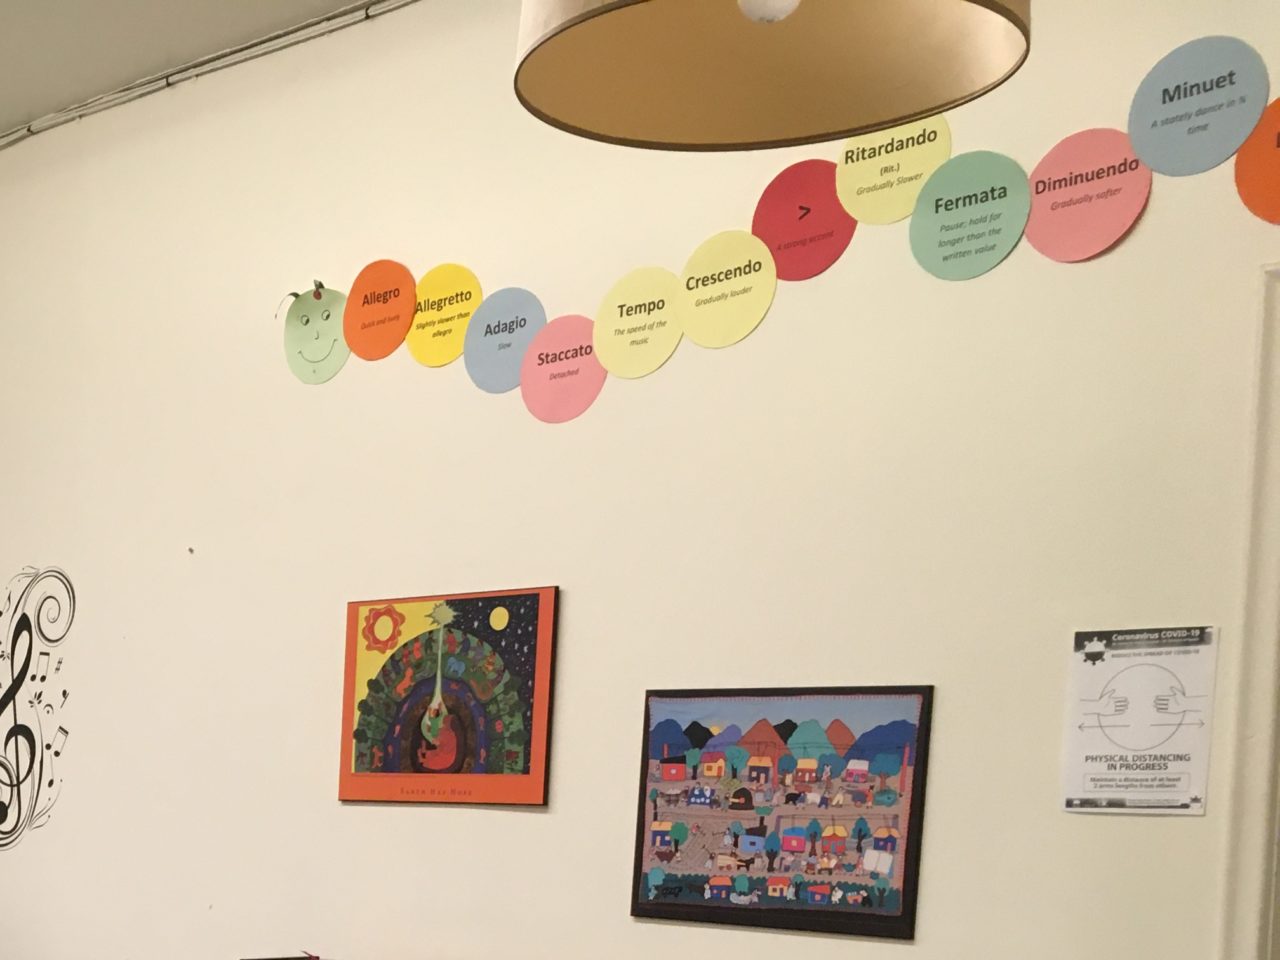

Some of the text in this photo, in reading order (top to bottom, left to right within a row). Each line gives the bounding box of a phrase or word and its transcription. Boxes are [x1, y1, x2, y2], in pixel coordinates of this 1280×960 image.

[1161, 70, 1236, 105] Minuet
[1150, 119, 1159, 130] A
[1160, 111, 1193, 127] stately
[1195, 102, 1224, 117] dance
[1226, 99, 1236, 109] in
[1186, 122, 1209, 136] time
[844, 127, 937, 165] Ritardando
[880, 163, 900, 177] (Rit.)
[1035, 158, 1139, 196] Diminuendo
[856, 171, 924, 196] Gradually Slower
[934, 184, 1008, 214] Fermata
[1050, 187, 1122, 211] Gradually softer
[968, 215, 988, 228] hold
[989, 211, 1002, 226] for
[938, 226, 1002, 250] longer than the
[942, 243, 997, 263] written value
[685, 258, 762, 291] Crescendo
[362, 288, 400, 307] Allegro
[415, 290, 472, 314] Allegretto
[695, 285, 753, 307] Gradually louder
[617, 297, 665, 318] Tempo
[416, 311, 470, 330] Slightly slower than
[484, 316, 527, 337] Adagio
[614, 319, 667, 337] The speed of the
[432, 328, 453, 338] allegro
[630, 336, 649, 347] music
[497, 341, 512, 351] Slow
[537, 343, 593, 366] Staccato
[549, 367, 580, 381] Detached
[1112, 629, 1200, 641] Coronavirus COVID-19
[1085, 753, 1191, 762] PHYSICAL DISTANCING
[1107, 762, 1169, 771] IN PROGRESS
